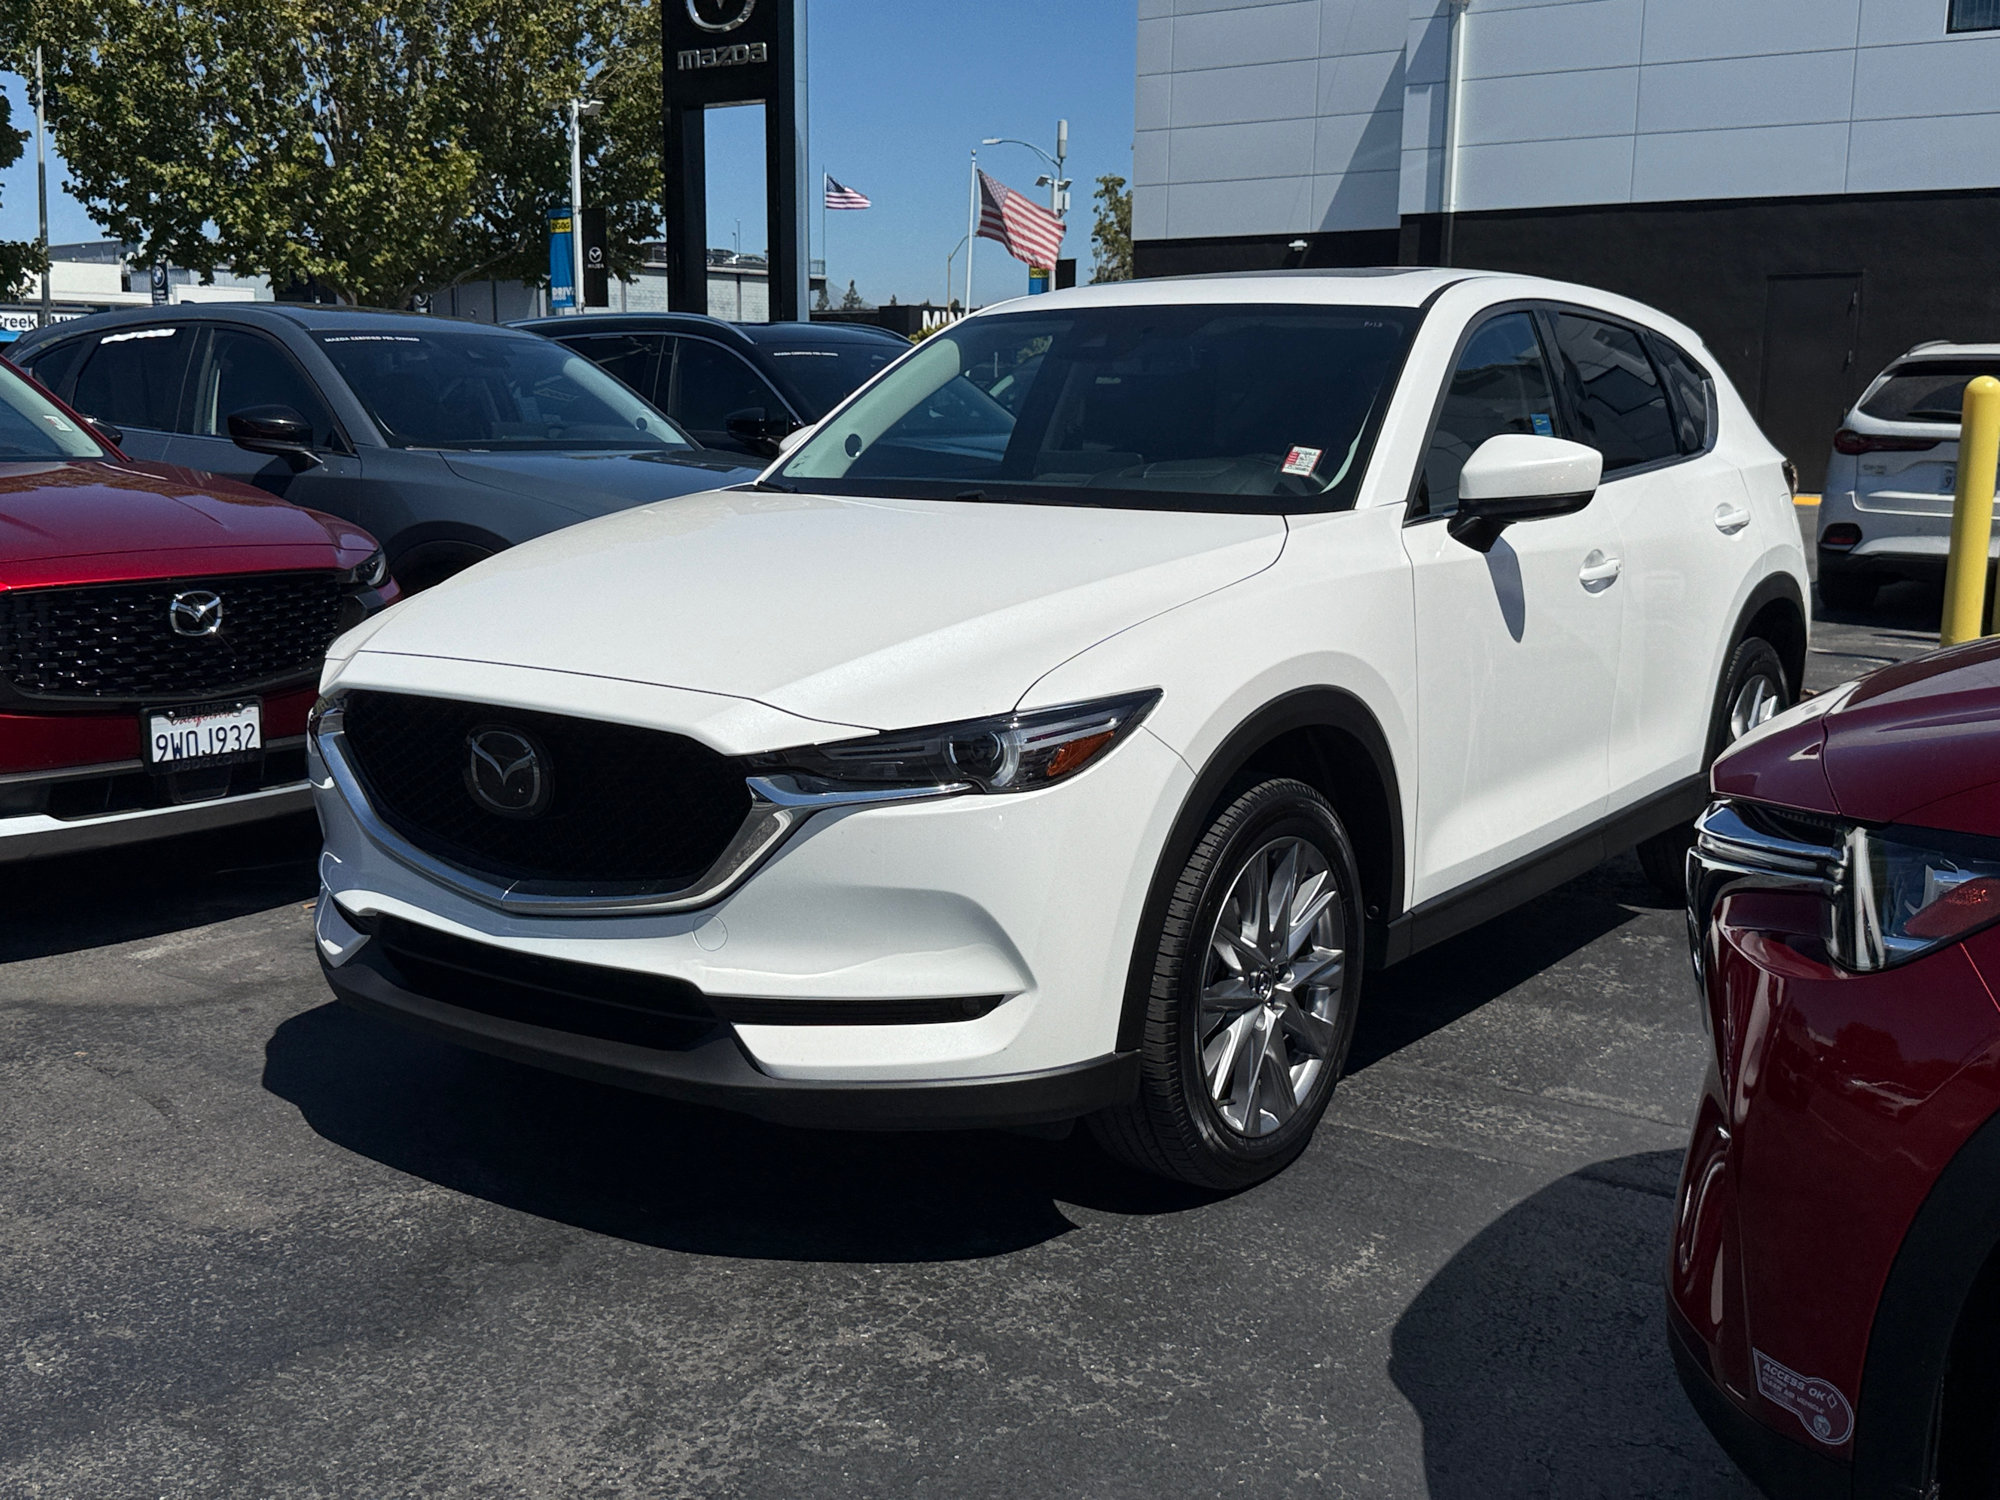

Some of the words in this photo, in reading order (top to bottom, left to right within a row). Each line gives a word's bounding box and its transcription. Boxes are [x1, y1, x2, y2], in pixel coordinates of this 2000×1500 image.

[922, 310, 968, 331] MIN
[1763, 1362, 1805, 1391] ACCESS
[1808, 1387, 1826, 1401] OK
